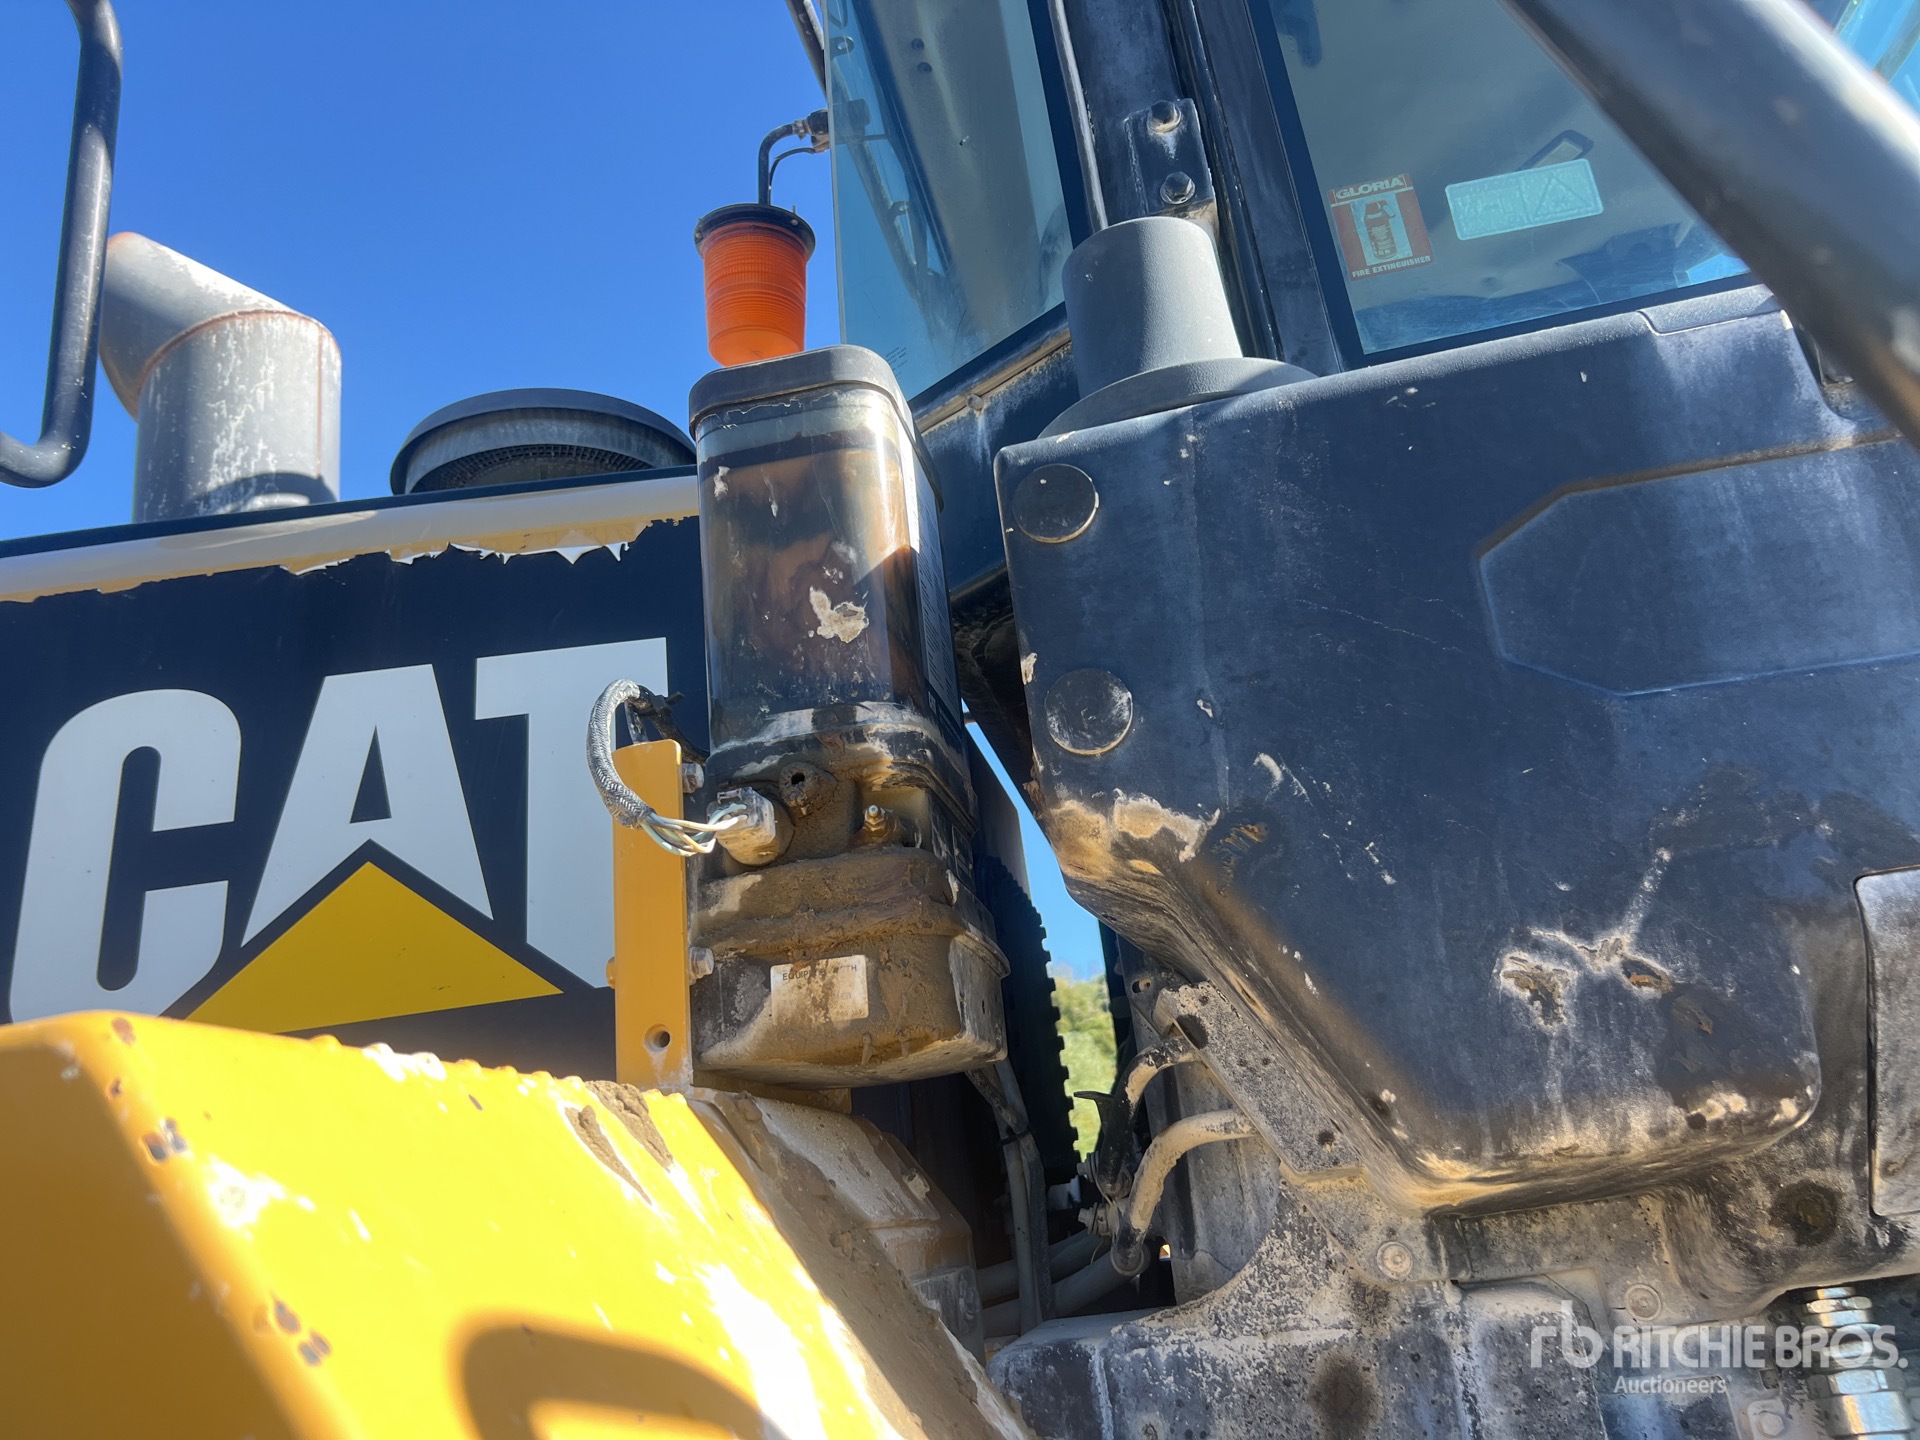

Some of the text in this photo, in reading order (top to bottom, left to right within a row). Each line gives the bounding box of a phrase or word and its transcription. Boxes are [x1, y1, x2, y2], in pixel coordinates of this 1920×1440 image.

[1336, 177, 1404, 199] GLORIA
[1352, 255, 1432, 278] FIRE EXTINGUISHER
[9, 637, 668, 1024] CAT
